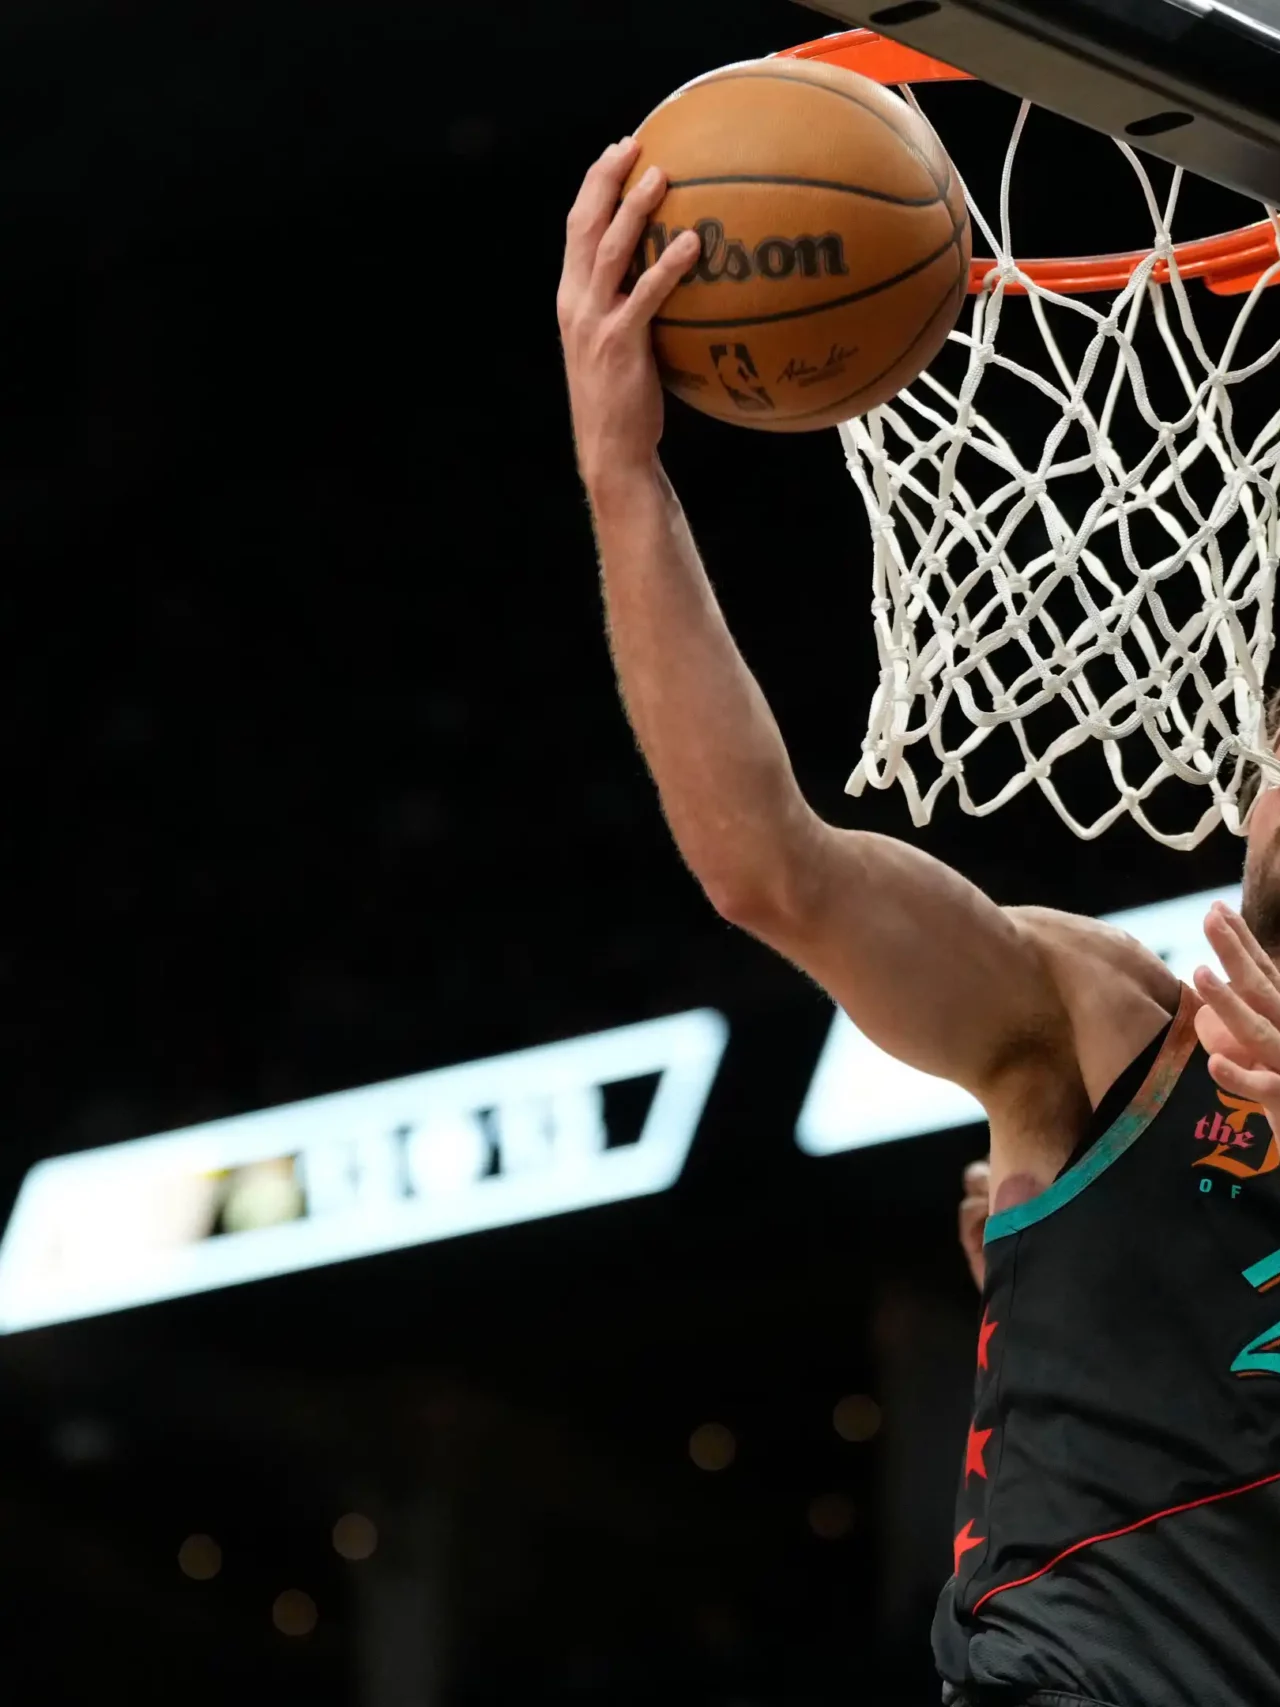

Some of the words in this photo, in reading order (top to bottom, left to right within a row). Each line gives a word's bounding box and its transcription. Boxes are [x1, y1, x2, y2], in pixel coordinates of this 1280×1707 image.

[632, 217, 849, 285] lson
[1193, 1112, 1255, 1148] the
[1199, 1178, 1242, 1199] OF
